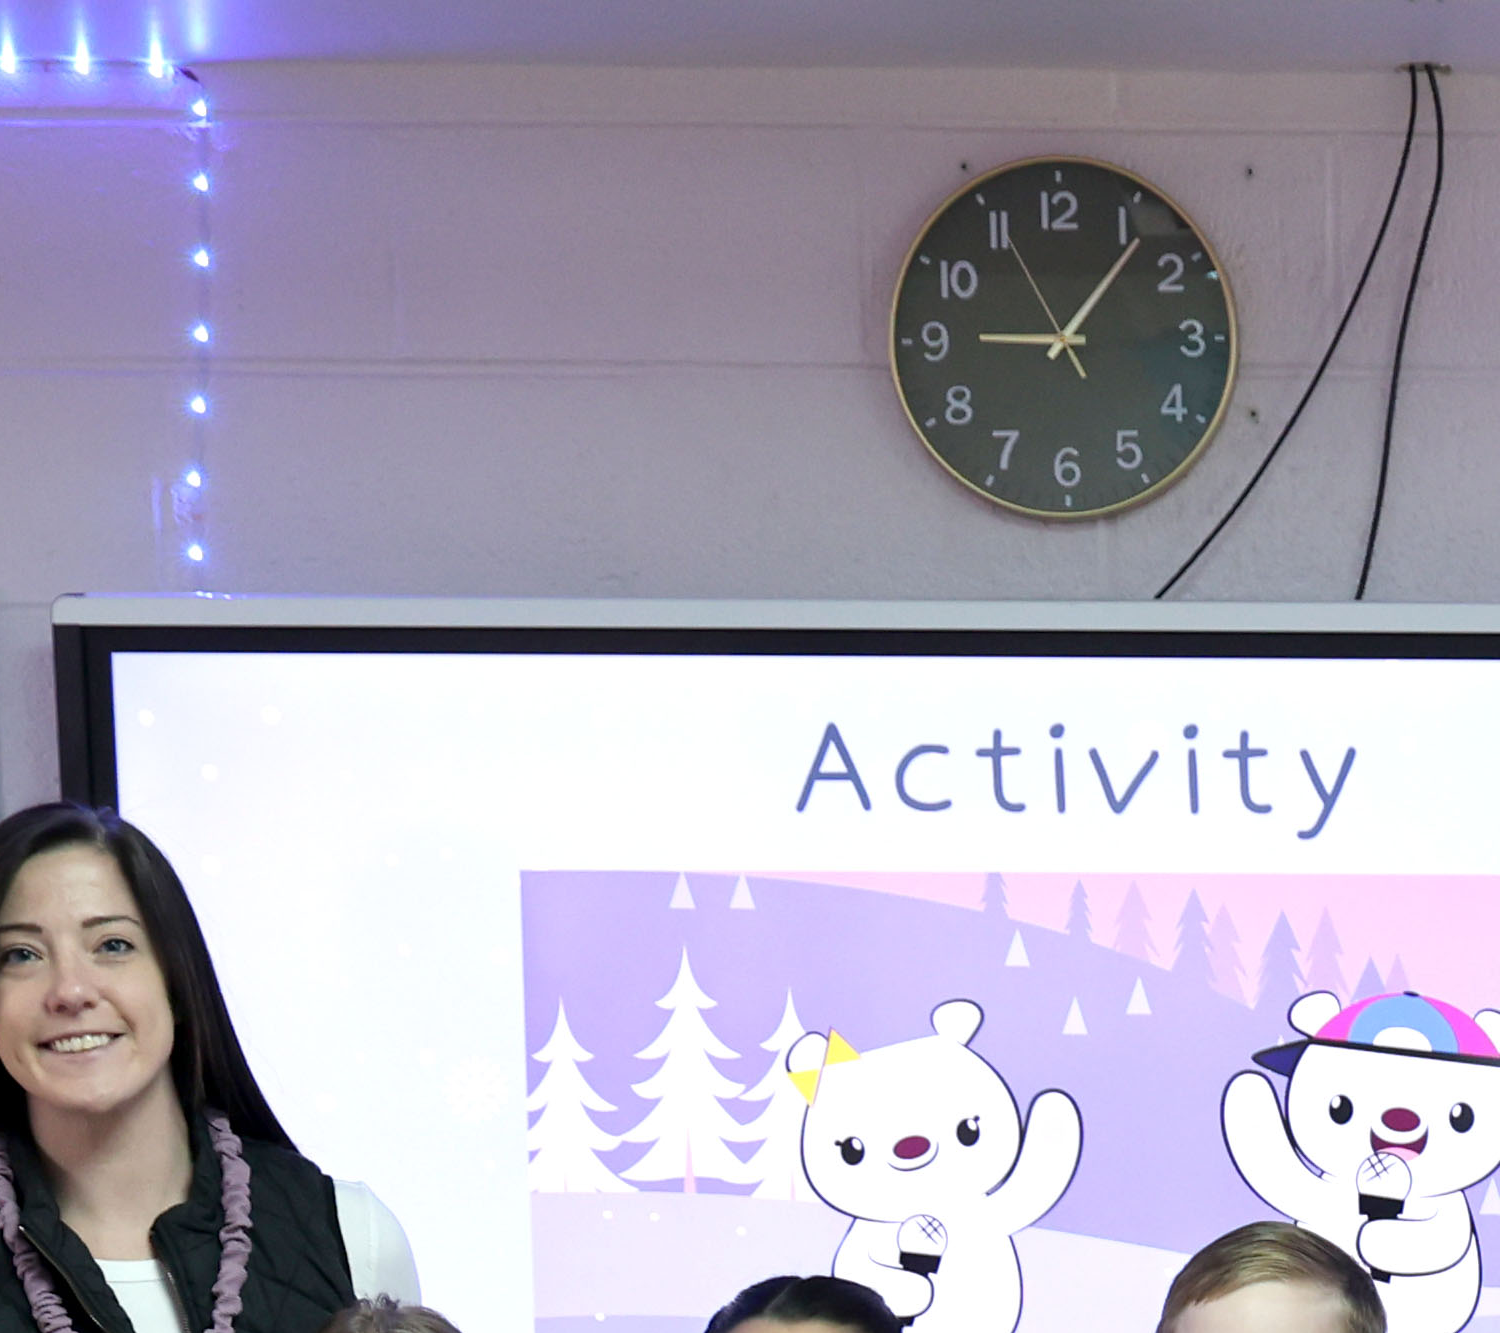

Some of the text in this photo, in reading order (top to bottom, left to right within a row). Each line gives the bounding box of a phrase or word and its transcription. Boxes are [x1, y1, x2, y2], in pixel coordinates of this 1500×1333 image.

[989, 210, 1009, 250] 11
[1040, 190, 1079, 231] 12
[1118, 206, 1127, 246] 1
[939, 259, 979, 299] 10
[1156, 253, 1185, 293] 2
[920, 321, 950, 362] 9
[1178, 318, 1207, 358] 3
[944, 385, 974, 425] 8
[1159, 383, 1189, 423] 4
[992, 429, 1020, 470] 7
[1053, 447, 1082, 487] 6
[1115, 430, 1144, 469] 5
[796, 719, 1360, 843] Activity
